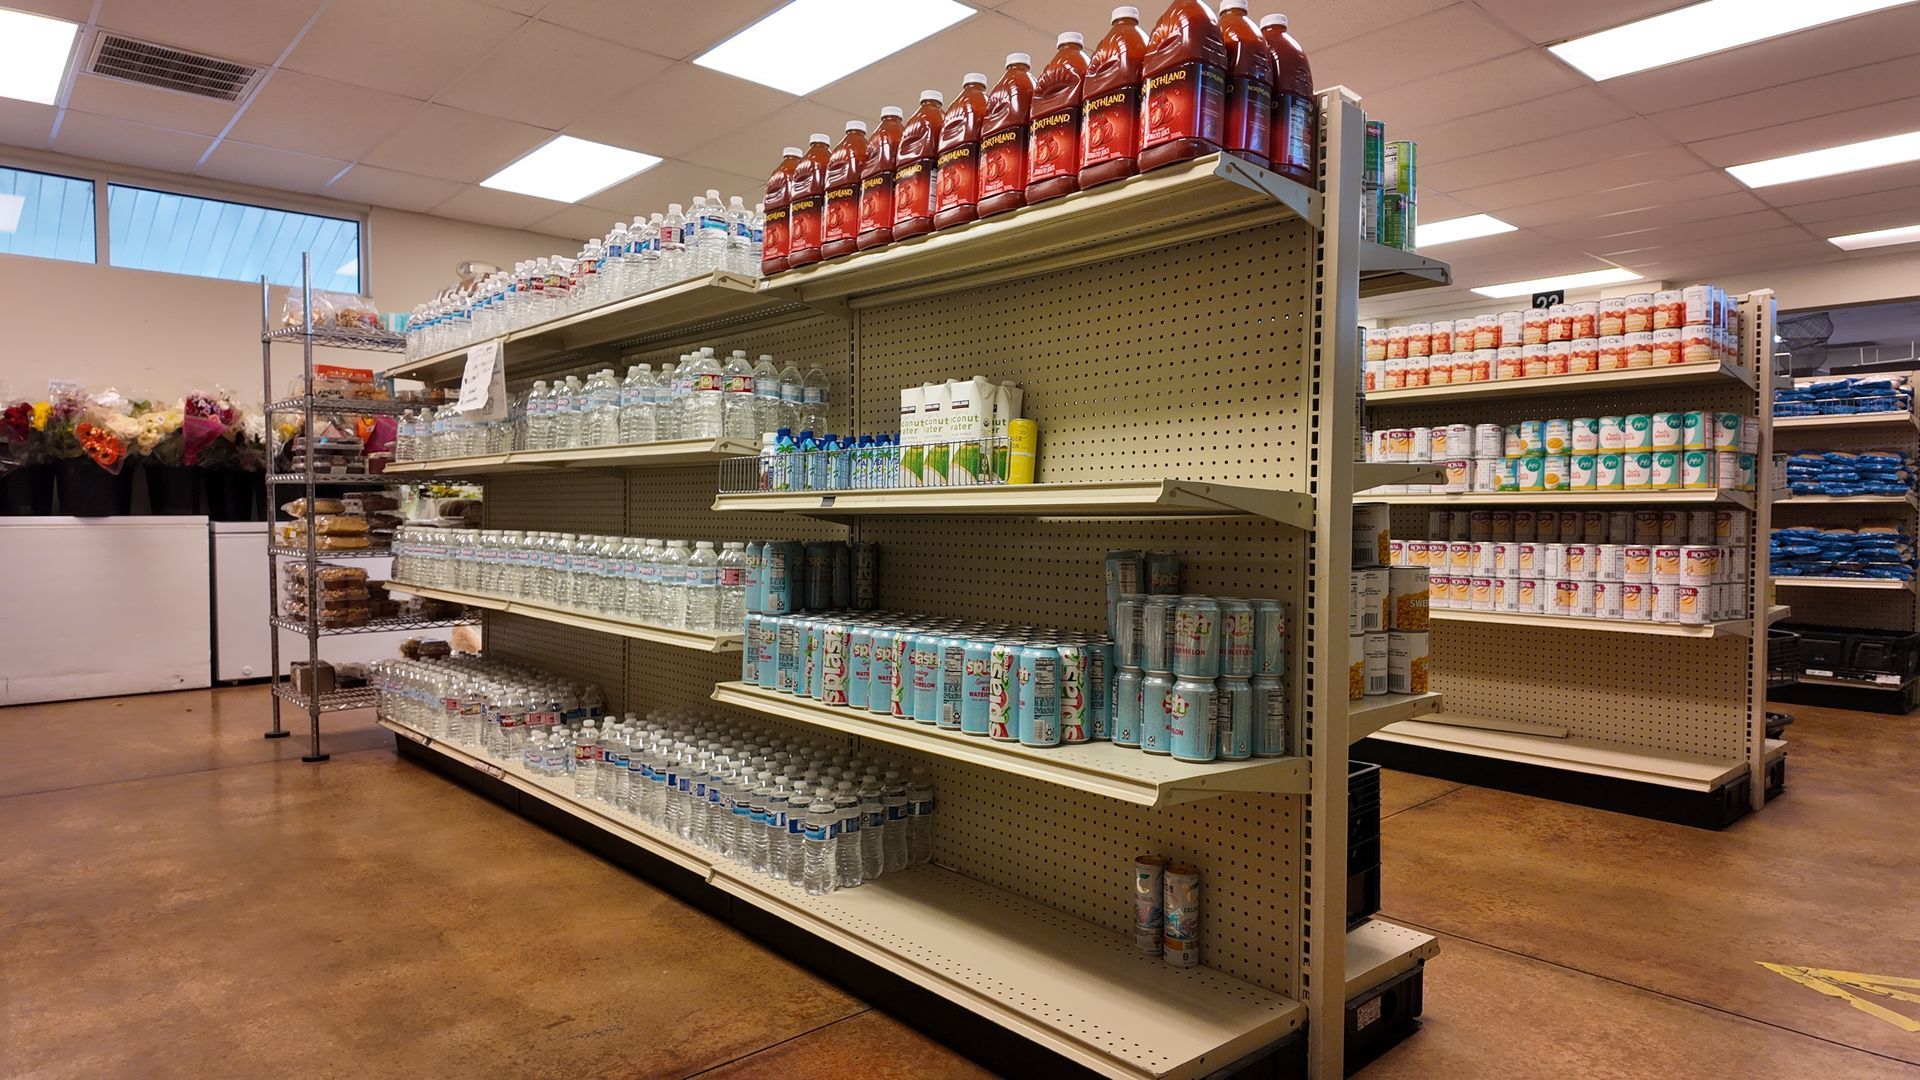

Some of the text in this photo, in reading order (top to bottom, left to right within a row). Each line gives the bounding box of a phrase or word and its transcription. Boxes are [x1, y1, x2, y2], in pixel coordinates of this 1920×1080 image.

[1082, 93, 1126, 115] NORTHLAND
[1030, 113, 1071, 133] NORTHLAND
[981, 132, 1016, 150] NORTHLAND
[937, 148, 970, 167] NORTHLAND
